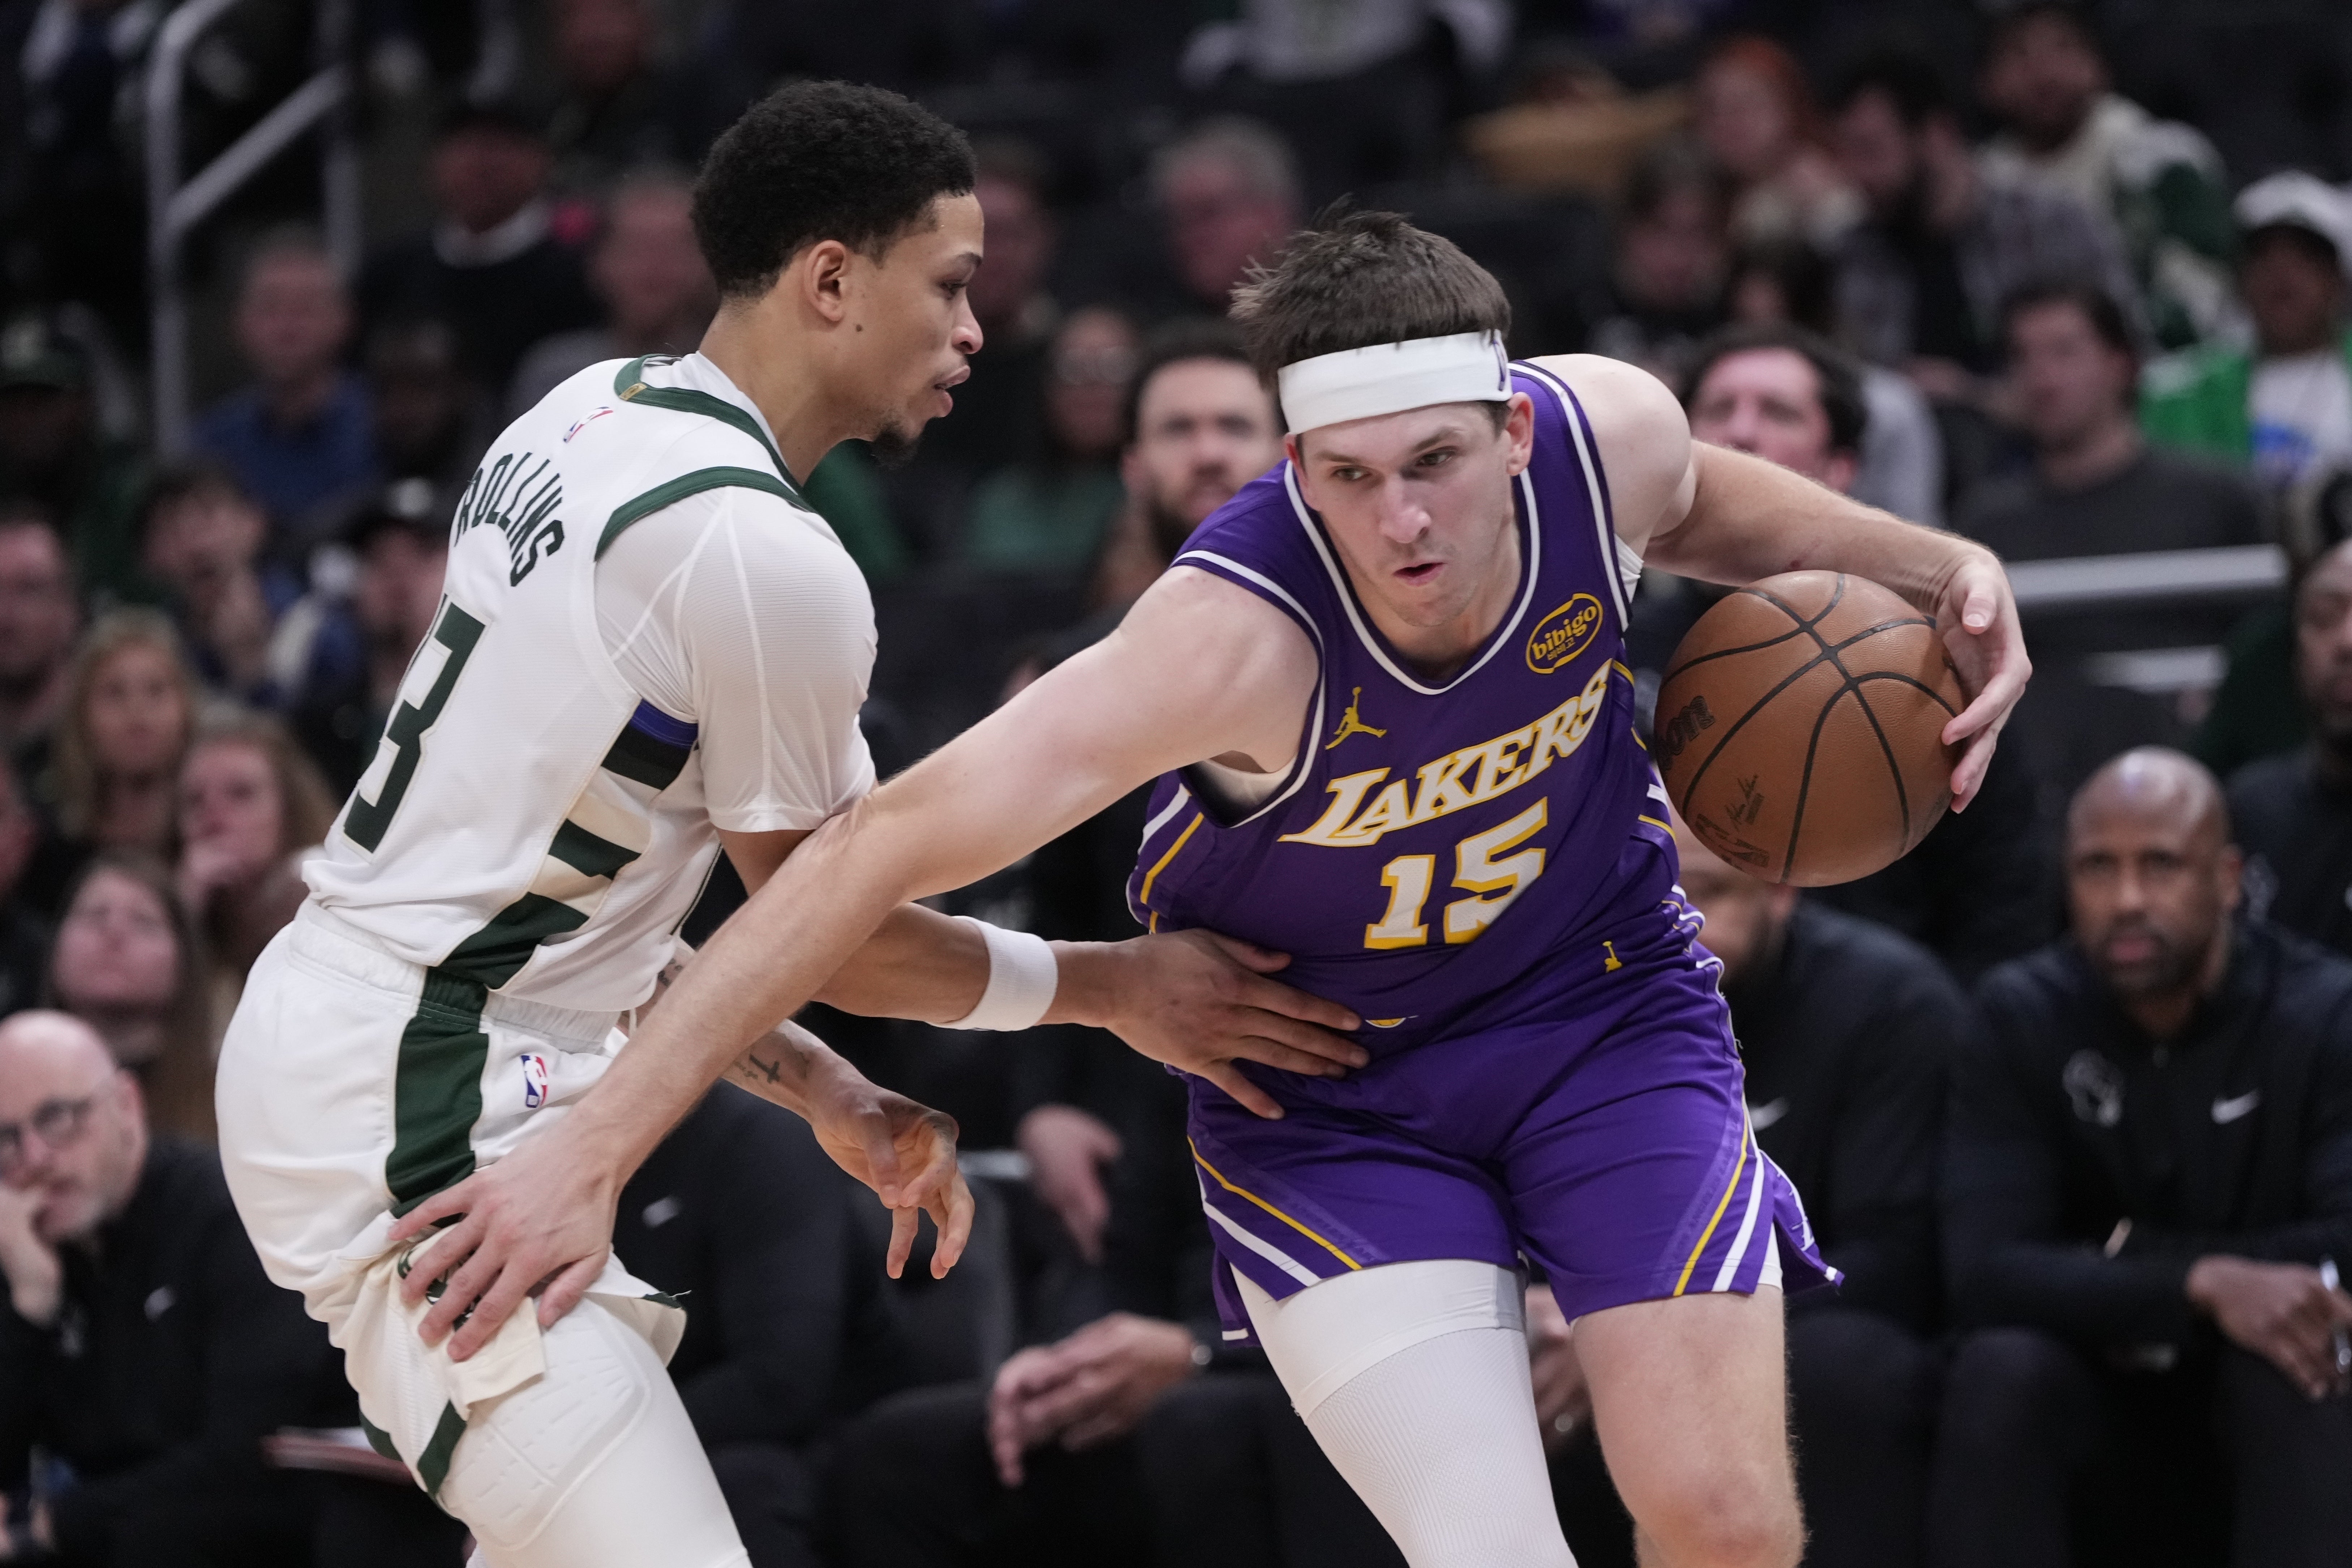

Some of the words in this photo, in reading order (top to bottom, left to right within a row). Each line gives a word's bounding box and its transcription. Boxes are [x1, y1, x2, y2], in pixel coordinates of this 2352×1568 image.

[454, 452, 565, 587] ROLLINS
[1532, 606, 1598, 660] bibigo
[342, 593, 488, 856] 3
[1276, 658, 1614, 847] LAKERS
[1364, 796, 1548, 949] 15
